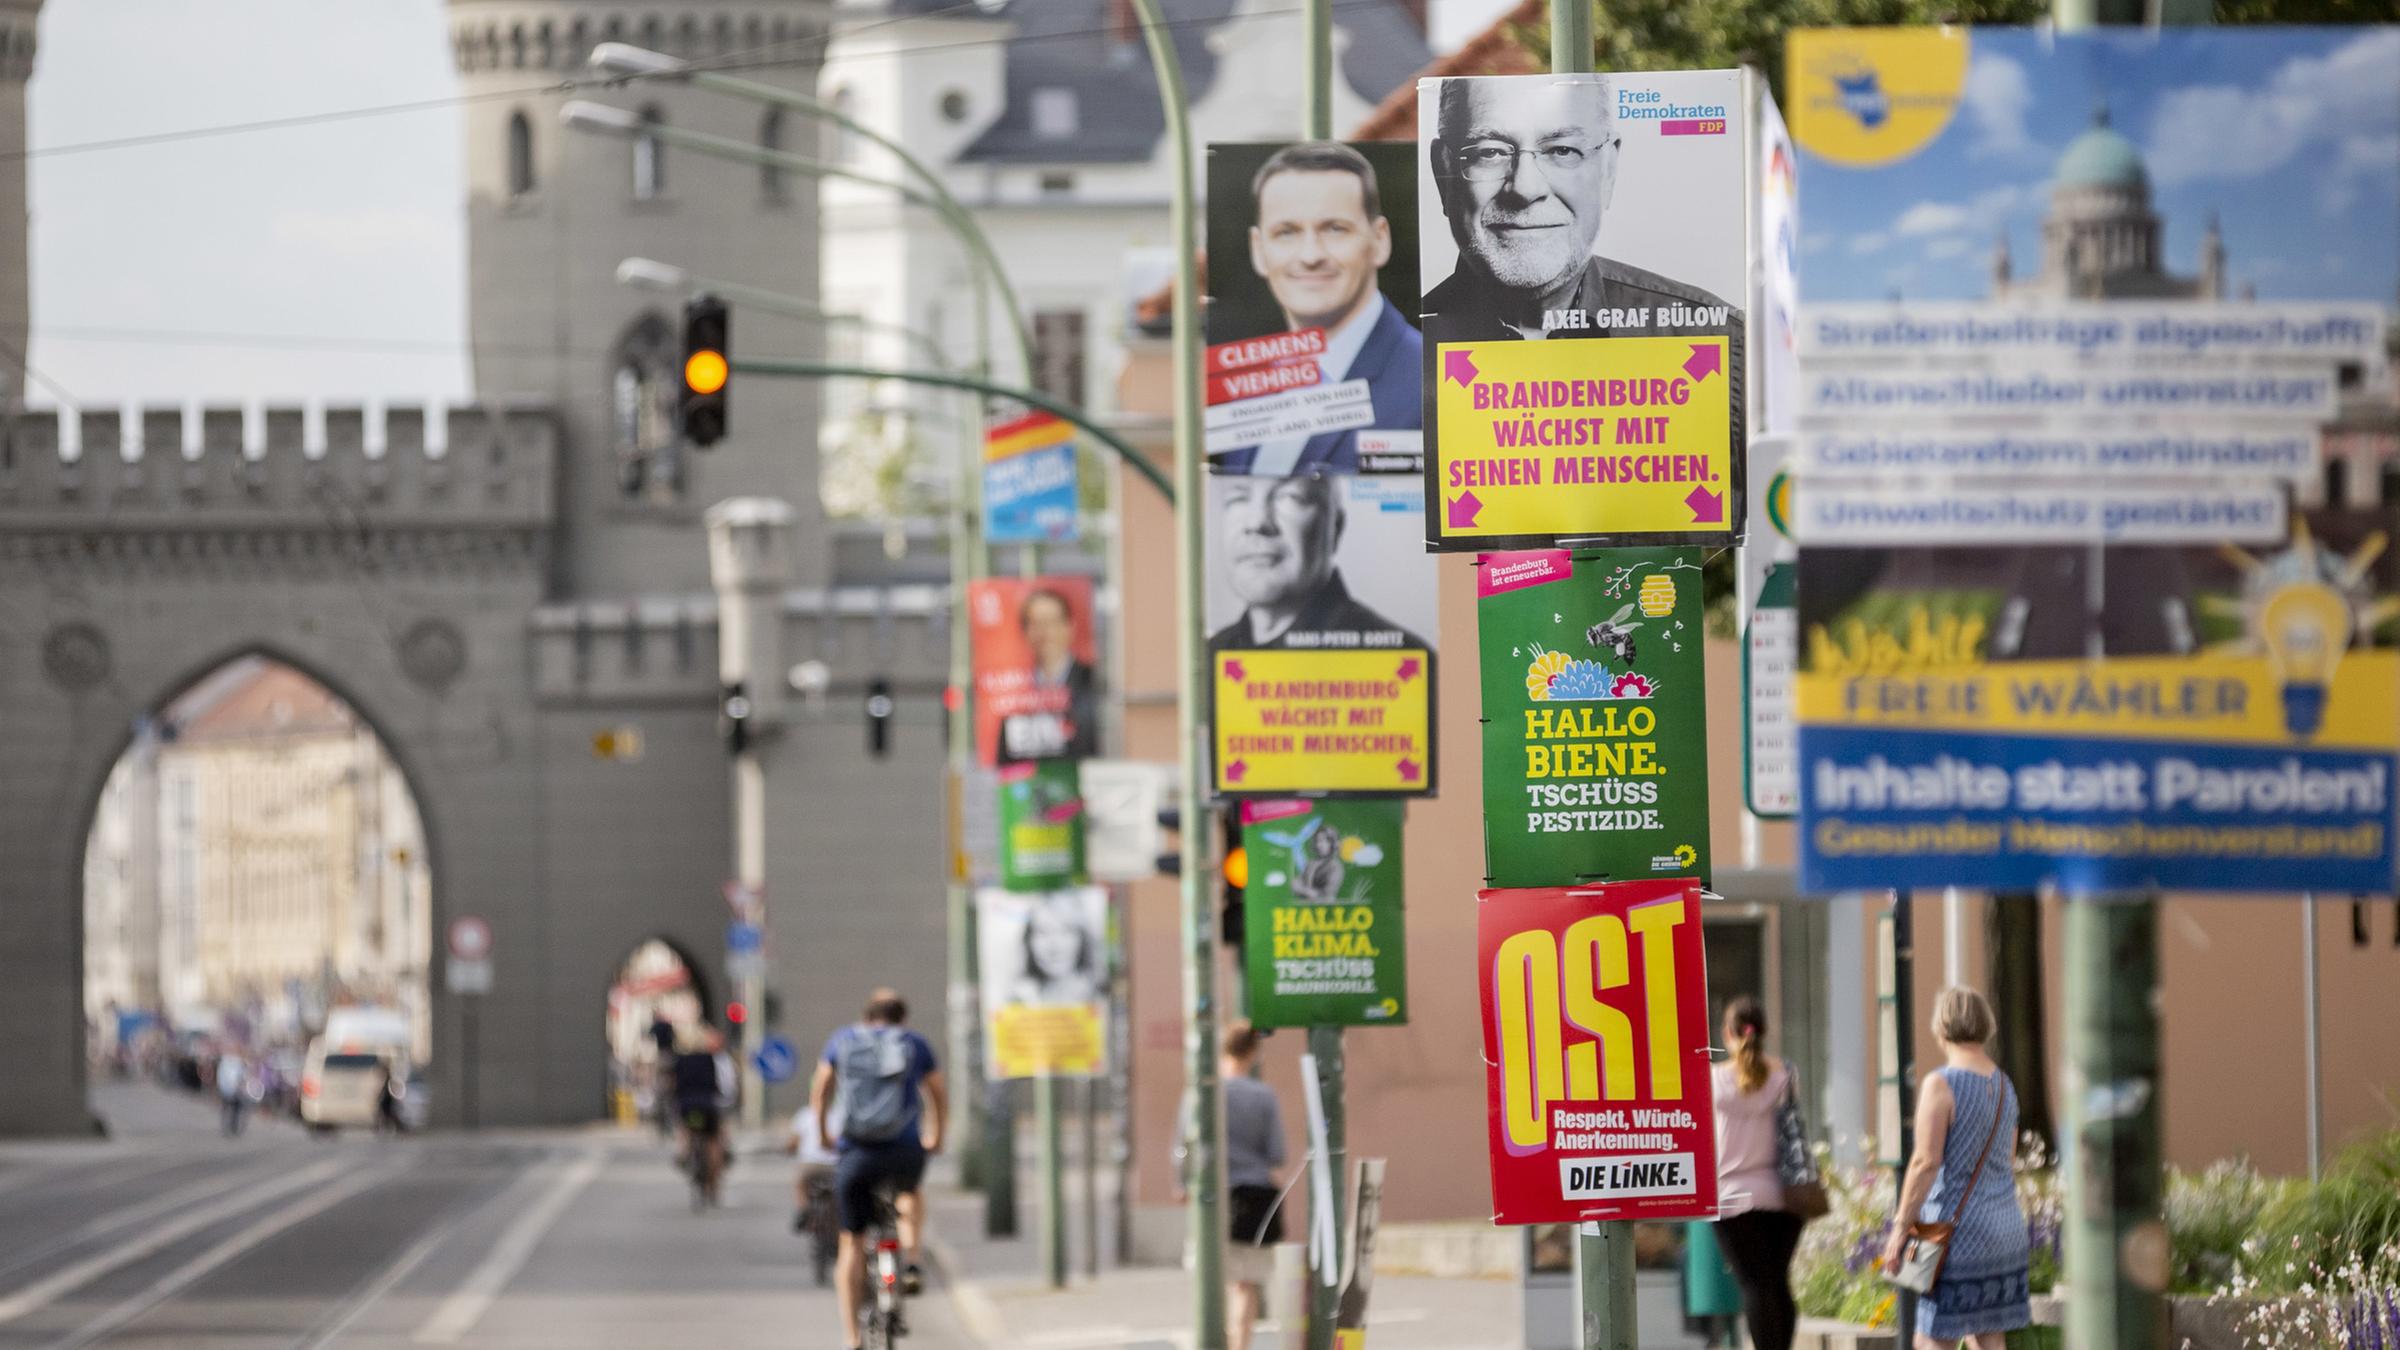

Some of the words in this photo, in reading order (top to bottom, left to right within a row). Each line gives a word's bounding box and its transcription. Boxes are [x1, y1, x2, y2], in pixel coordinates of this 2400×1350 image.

[1618, 89, 1661, 103] Freie
[1618, 104, 1726, 119] Demokraten
[1699, 122, 1724, 133] FDP
[1541, 309, 1590, 330] AXEL
[1597, 307, 1650, 328] GRAF
[1657, 302, 1729, 327] BÜLOW
[1218, 330, 1323, 369] CLEMENS
[1223, 362, 1317, 397] VIEHRIG
[1473, 377, 1690, 410] BRANDENBURG
[1493, 412, 1604, 447] WÄCHST
[1615, 417, 1670, 444] MIT
[1450, 458, 1541, 487] SEINEN
[1553, 455, 1720, 484] MENSCHEN.
[1490, 558, 1548, 577] Brandenburg
[1492, 576, 1503, 586] ist
[1503, 566, 1556, 583] erneuerbar.
[1245, 680, 1400, 700] BRANDENBURG
[1845, 675, 1990, 715] FREIE
[2011, 672, 2250, 721] WÄHLER
[1260, 704, 1339, 726] WÄCHST
[1349, 707, 1387, 726] MIT
[1525, 706, 1656, 739] HALLO
[1227, 736, 1294, 754] SEINEN
[1303, 734, 1419, 755] MENSCHEN.
[1526, 742, 1667, 778] BIENE.
[1526, 778, 1657, 807] TSCHÜSS
[1814, 754, 2010, 812] Inhalte
[2015, 759, 2147, 812] statt
[2155, 757, 2387, 814] Parolen!
[1527, 809, 1665, 832] PESTIZIDE.
[1273, 906, 1375, 932] HALLO
[1273, 933, 1380, 958] KLIMA.
[1275, 957, 1375, 979] TSCHÜSS
[1493, 893, 1685, 1157] OST
[1554, 1109, 1629, 1130] Respekt,
[1632, 1109, 1697, 1130] Würde,
[1554, 1131, 1678, 1151] Anerkennung.
[1570, 1165, 1606, 1191] DIE
